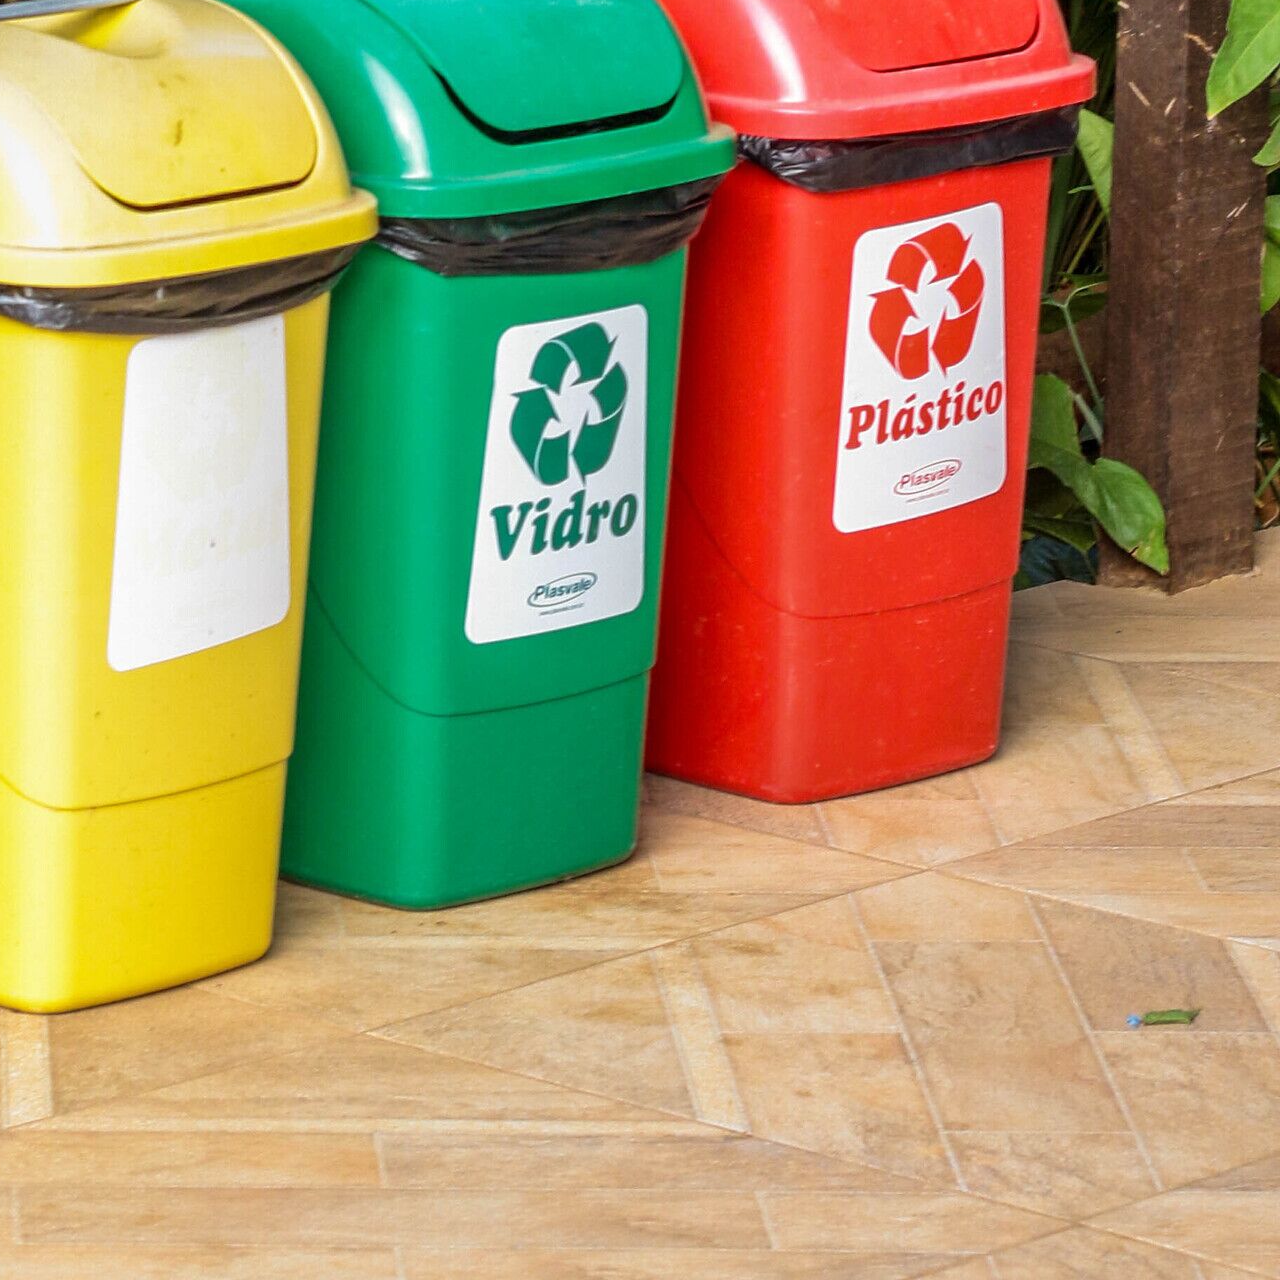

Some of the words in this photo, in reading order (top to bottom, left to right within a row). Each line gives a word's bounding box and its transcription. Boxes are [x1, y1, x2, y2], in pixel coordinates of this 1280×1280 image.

[844, 381, 1003, 450] Plástico
[899, 465, 956, 489] Plasvale
[490, 489, 638, 561] Vidro
[533, 578, 592, 601] Plasvale
